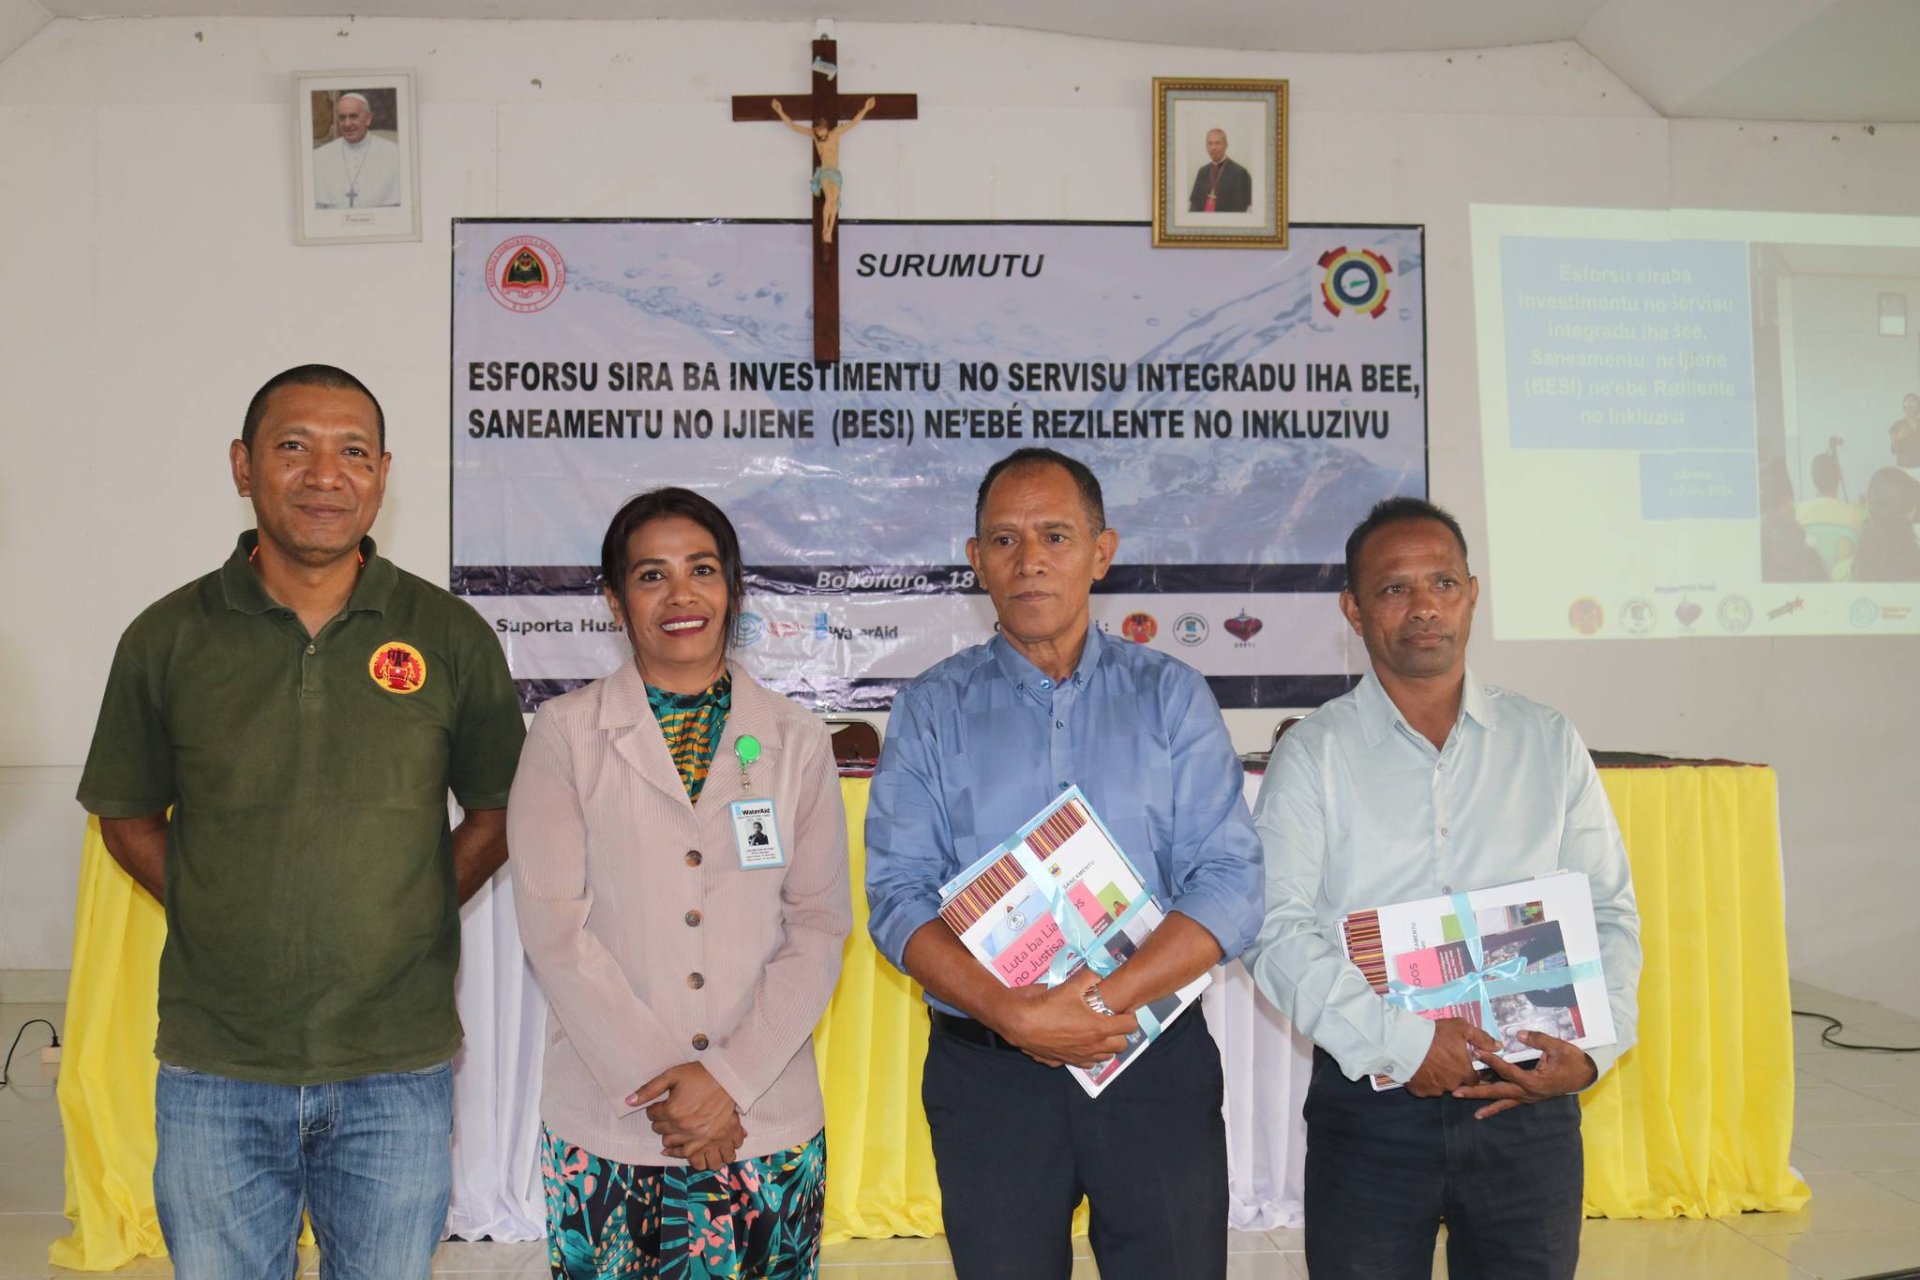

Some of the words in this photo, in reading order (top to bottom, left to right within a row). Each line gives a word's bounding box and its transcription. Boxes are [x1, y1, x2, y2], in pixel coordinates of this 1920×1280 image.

[857, 254, 1043, 277] SURUMUTU
[470, 362, 597, 391] ESFORSU
[608, 363, 672, 391] SIRA
[684, 363, 720, 391] BA
[731, 363, 941, 391] INVESTIMENTU
[960, 363, 998, 391] NO
[1009, 363, 1126, 392] SERVISU
[1138, 363, 1295, 392] INTEGRADU
[1307, 364, 1351, 391] IHA
[1363, 363, 1420, 398] BEE,
[469, 410, 662, 438] SANEAMENTU
[675, 410, 712, 438] NO
[724, 410, 813, 438] IJIENE
[833, 409, 914, 446] (BESI)
[1033, 410, 1183, 438] REZILENTE
[1195, 410, 1231, 438] NO
[1243, 411, 1388, 438] INKLUZIVU
[950, 571, 975, 588] 18
[496, 619, 573, 636] Suporta
[829, 626, 898, 640] WaerAid
[1002, 951, 1028, 974] Luta
[1026, 936, 1043, 952] ba
[1042, 921, 1059, 939] Lia
[1014, 970, 1030, 986] no
[1031, 938, 1065, 971] Justisa
